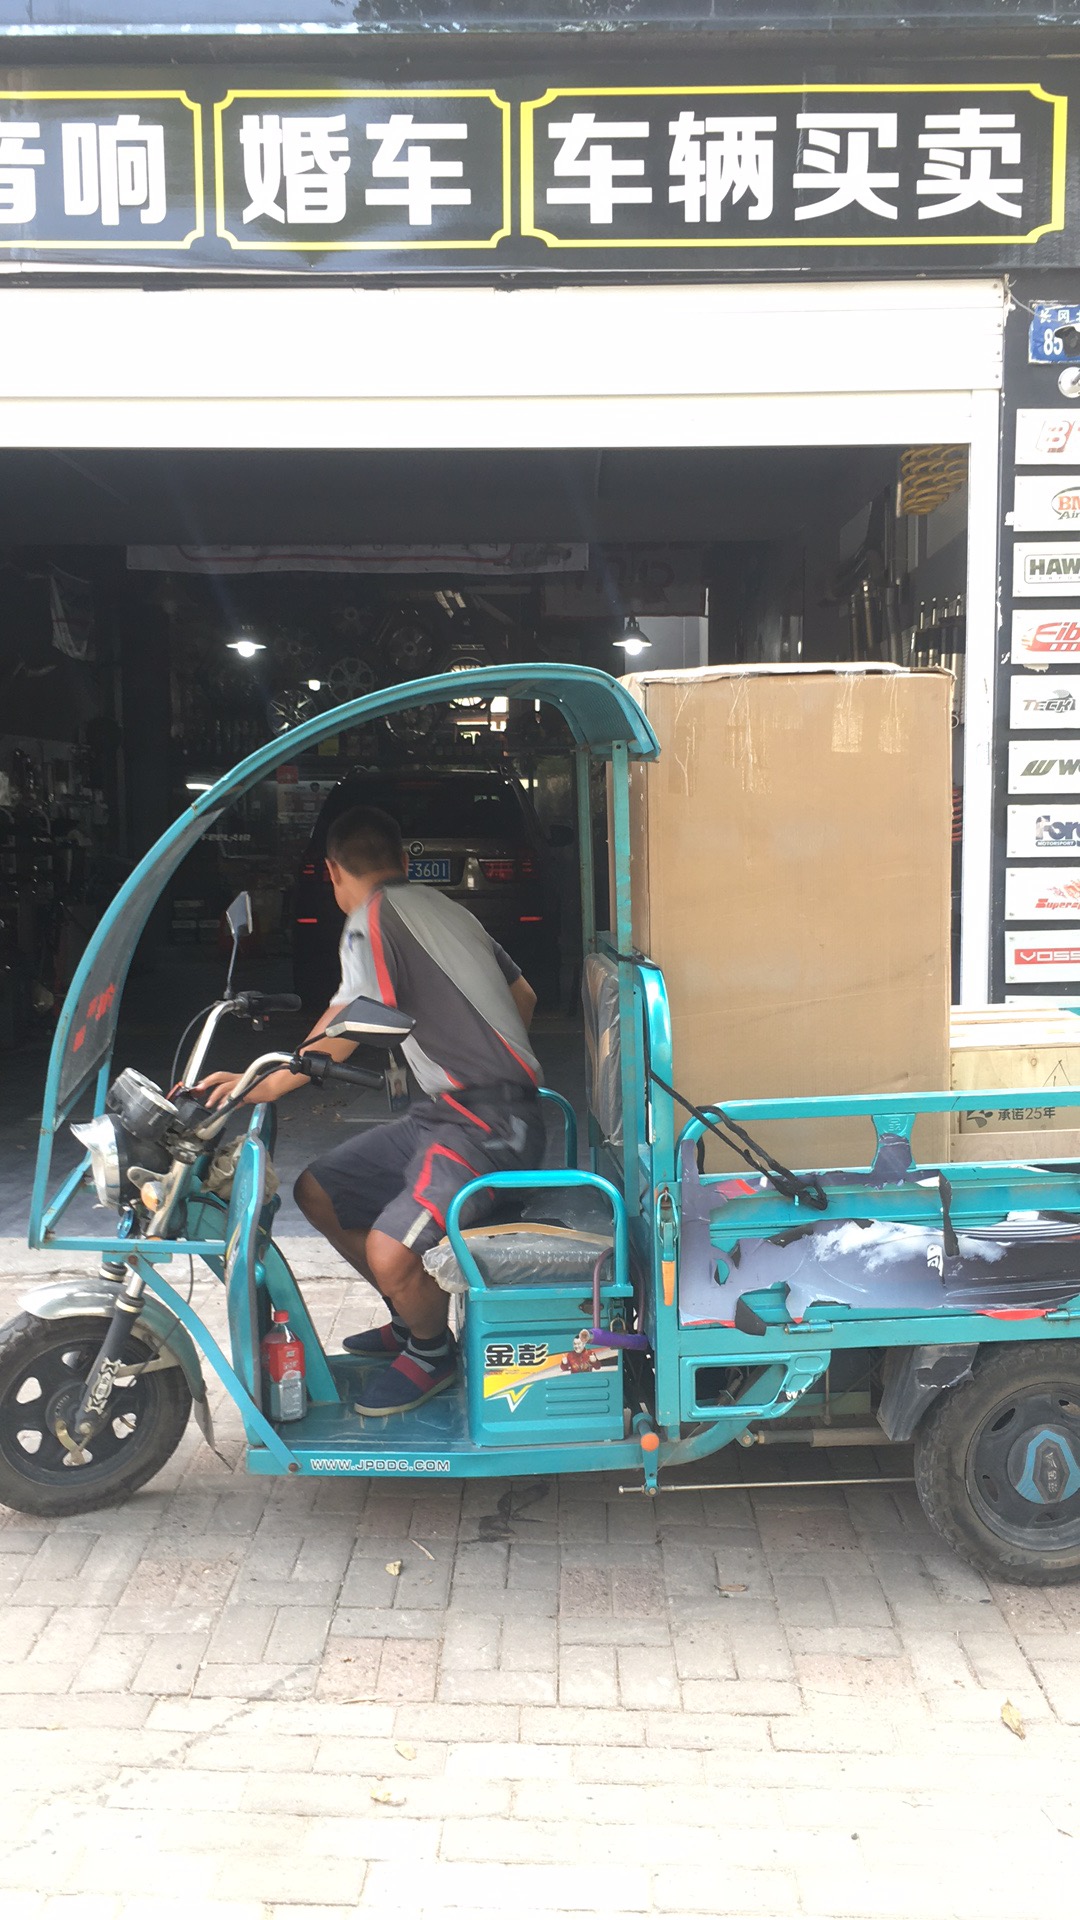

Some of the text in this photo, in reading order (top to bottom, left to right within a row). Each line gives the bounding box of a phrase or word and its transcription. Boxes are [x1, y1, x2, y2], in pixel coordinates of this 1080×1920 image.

[239, 114, 472, 226] 婚车
[545, 108, 1024, 224] 车辆买卖
[1036, 420, 1080, 453] B
[1029, 558, 1080, 575] HAW
[1019, 951, 1080, 962] VOSS
[998, 1106, 1056, 1121] 承诺25年
[484, 1342, 549, 1368] 金彭
[310, 1458, 450, 1471] WWW.JPDDC.COM
